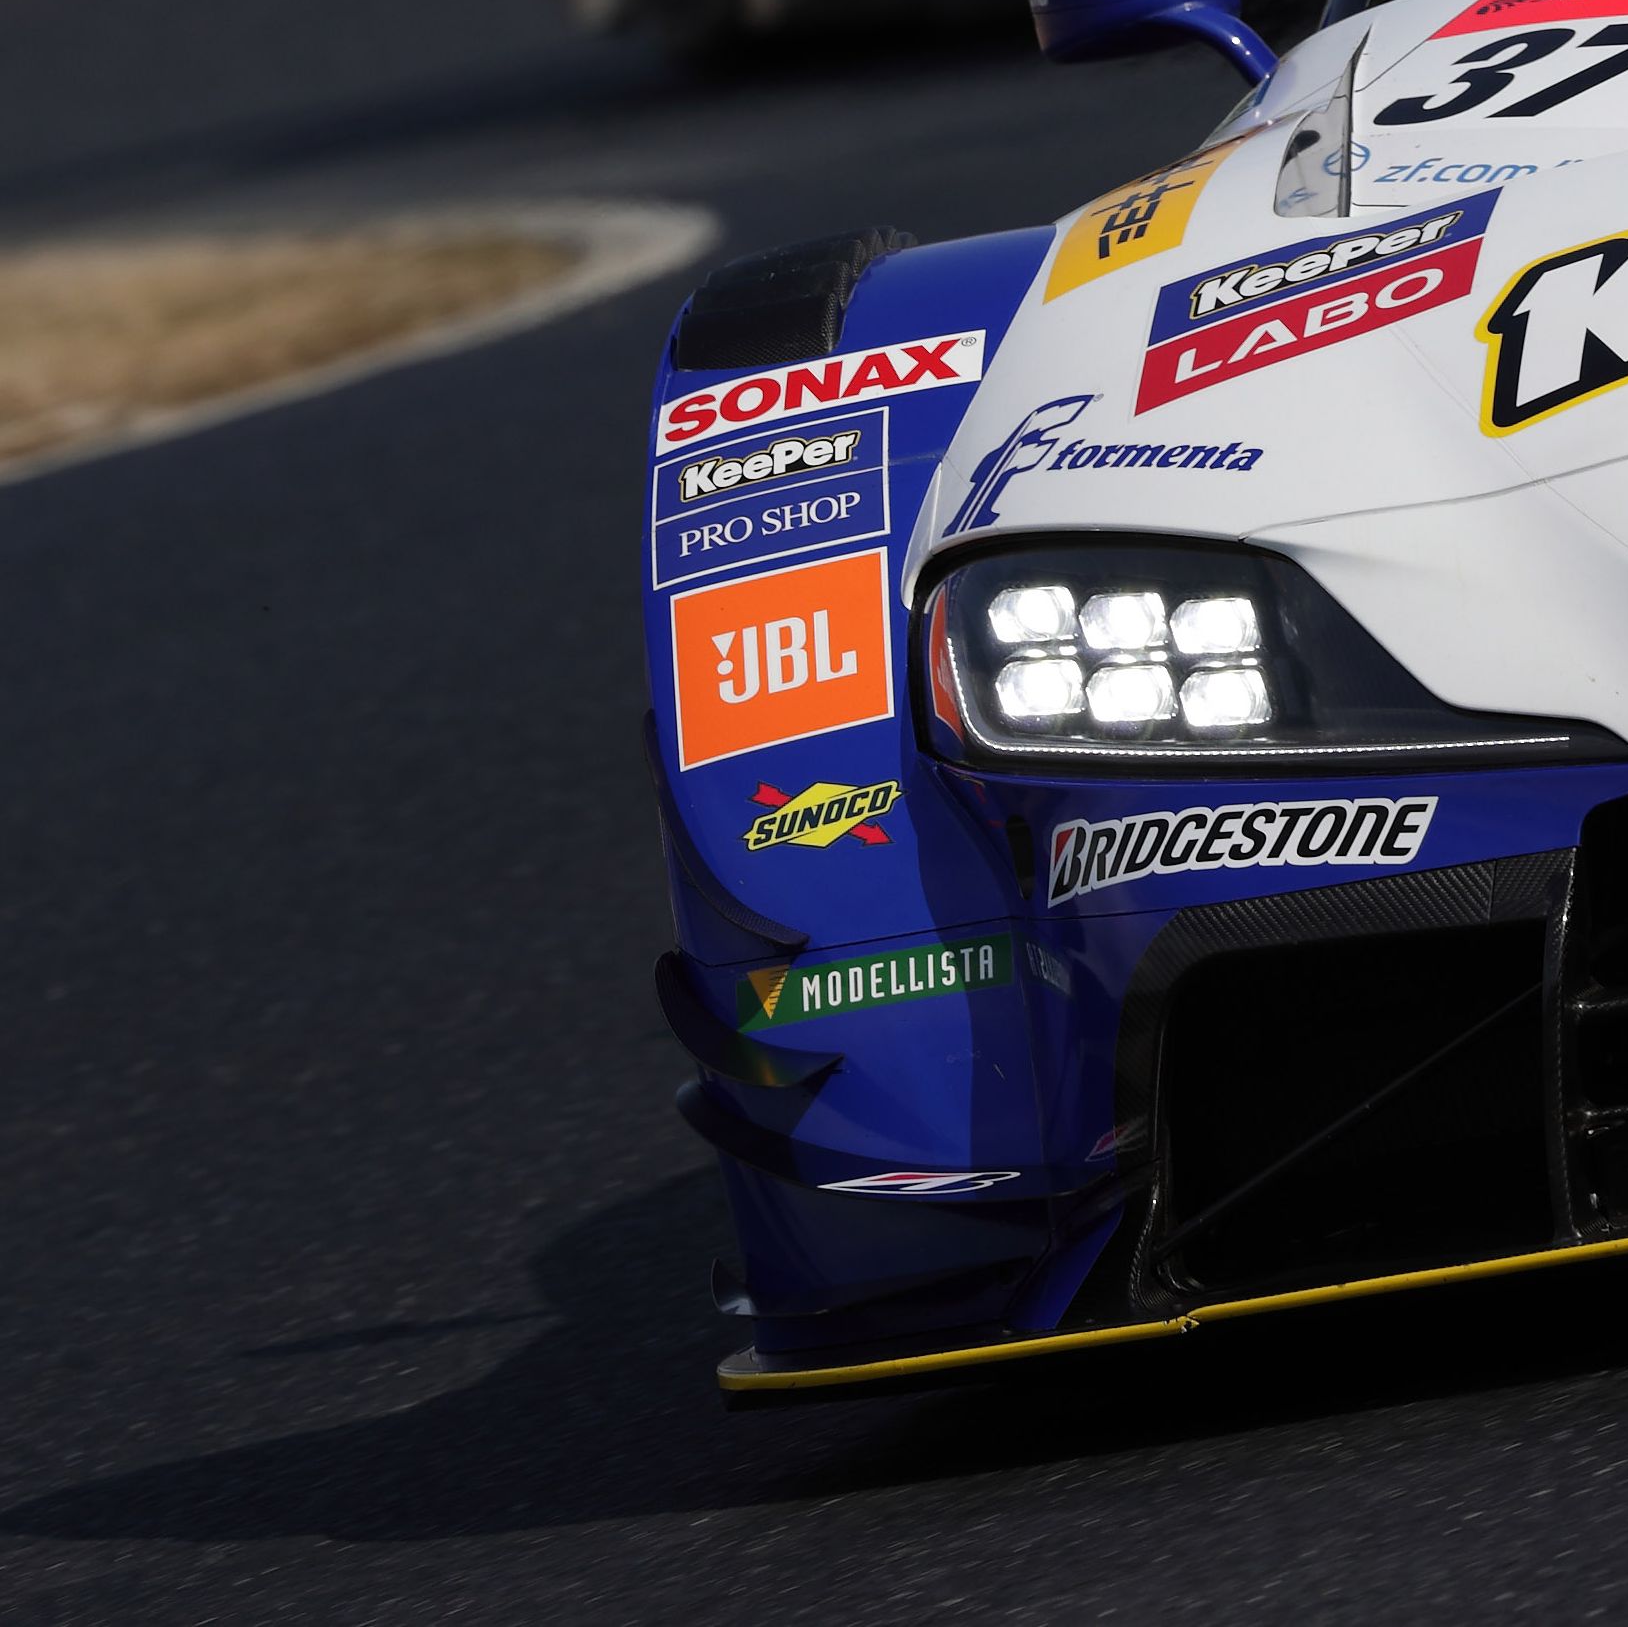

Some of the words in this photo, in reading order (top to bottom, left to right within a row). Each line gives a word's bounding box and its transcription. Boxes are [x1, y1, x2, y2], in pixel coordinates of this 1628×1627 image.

[1190, 210, 1464, 320] KeePer
[1172, 266, 1446, 386] LABO
[663, 338, 964, 442] SONAX
[680, 430, 862, 502] KeePer
[678, 516, 754, 558] PRO
[760, 492, 862, 536] SHOP
[711, 608, 858, 706] JBL
[750, 788, 896, 848] SUNOCO
[1050, 796, 1432, 906] BRIDGESTONE
[801, 944, 997, 1014] MODELLISTA
